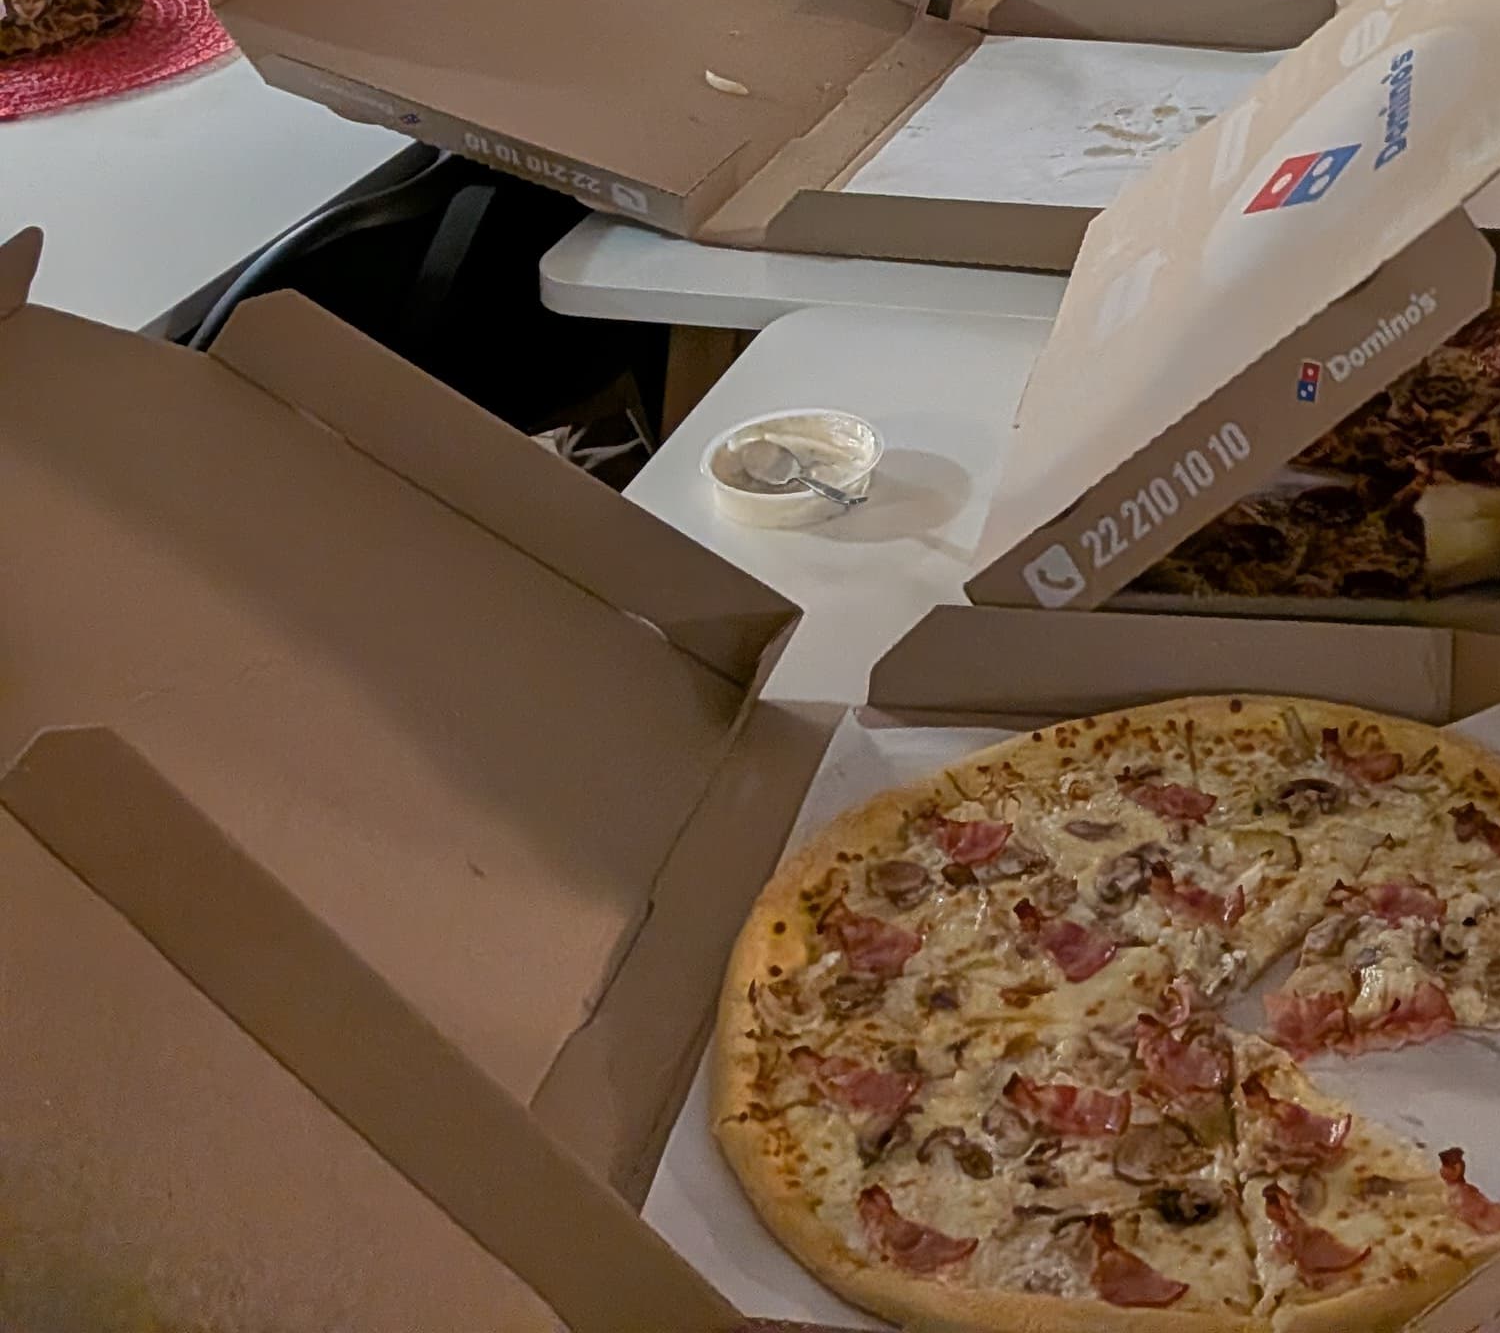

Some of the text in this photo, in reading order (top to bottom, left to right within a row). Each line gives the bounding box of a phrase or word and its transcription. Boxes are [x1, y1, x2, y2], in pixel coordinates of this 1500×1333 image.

[1374, 48, 1414, 171] Domino's
[1326, 290, 1438, 382] Domino's
[1080, 422, 1251, 568] 22 210 10 10
